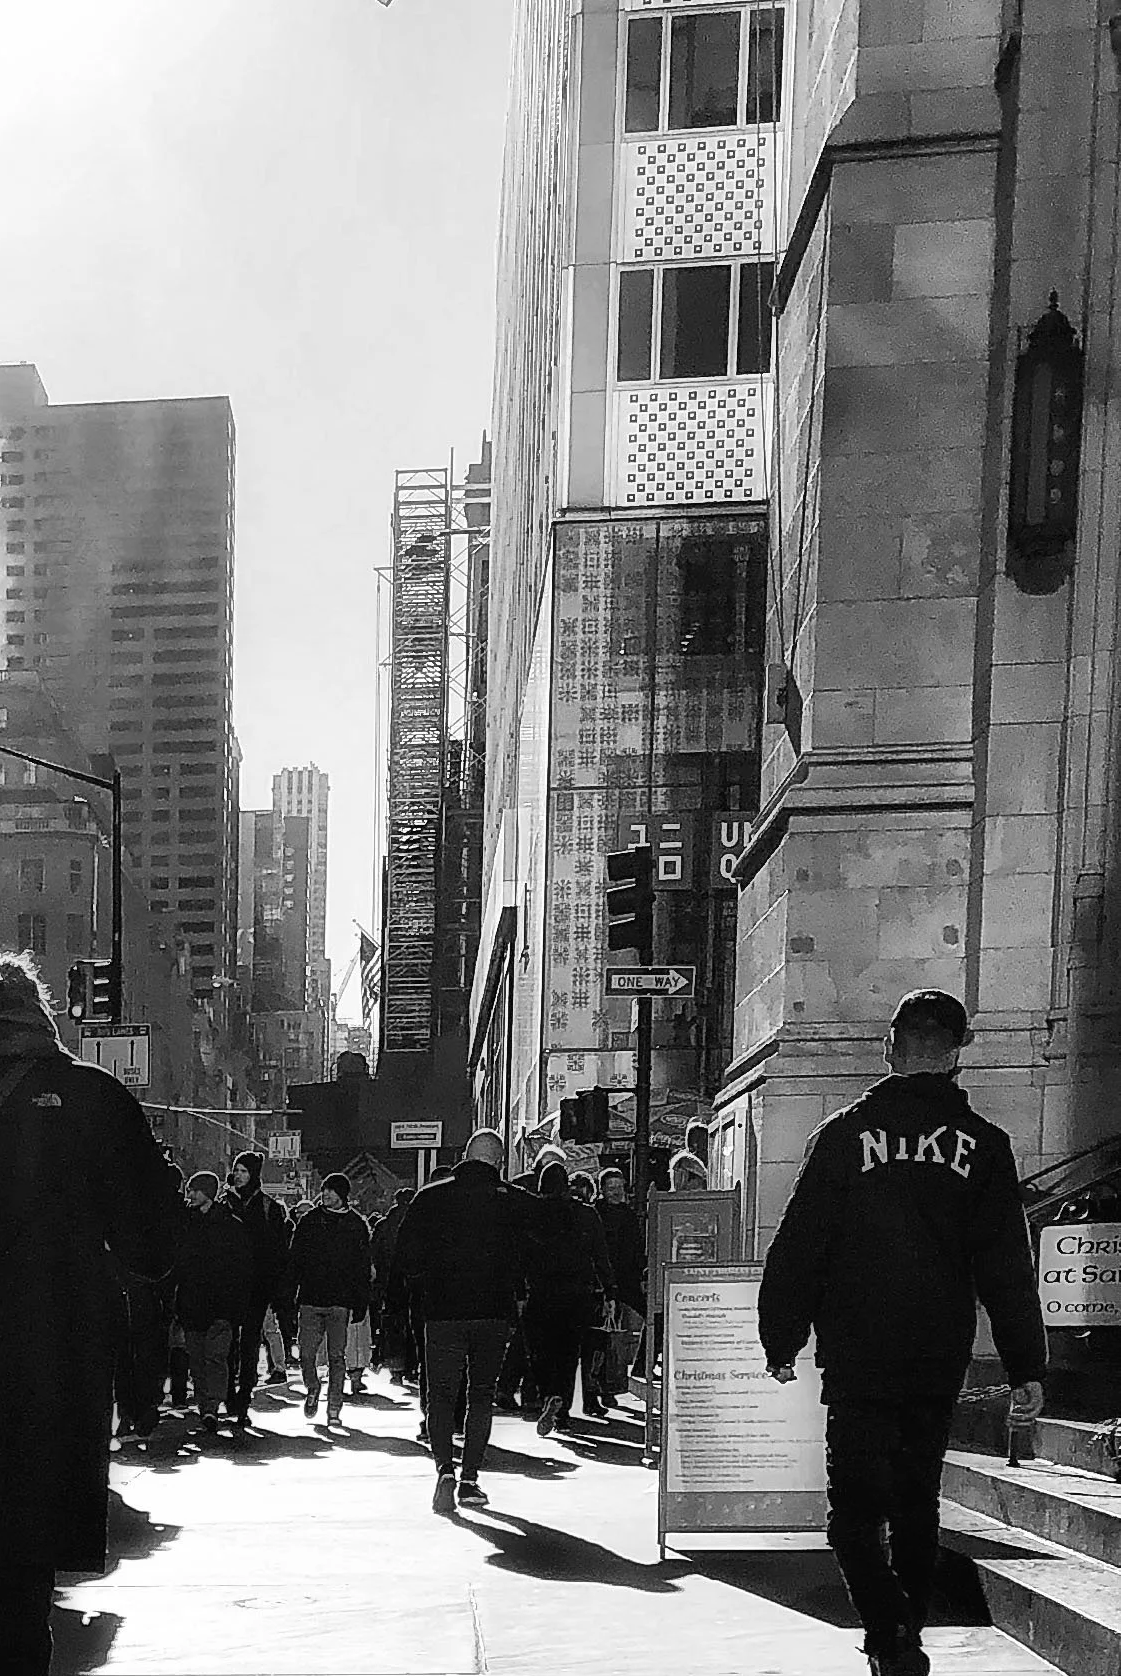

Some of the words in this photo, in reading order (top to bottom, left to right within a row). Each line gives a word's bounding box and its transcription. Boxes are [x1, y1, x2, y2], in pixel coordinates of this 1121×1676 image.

[617, 976, 643, 988] ONE
[654, 976, 680, 988] WAY
[859, 1125, 976, 1178] NIKE
[1056, 1235, 1121, 1255] Chri
[1043, 1267, 1077, 1284] at
[675, 1292, 721, 1303] Concerts
[1046, 1300, 1061, 1313] O
[1064, 1303, 1119, 1315] come,
[673, 1369, 726, 1382] Christmas
